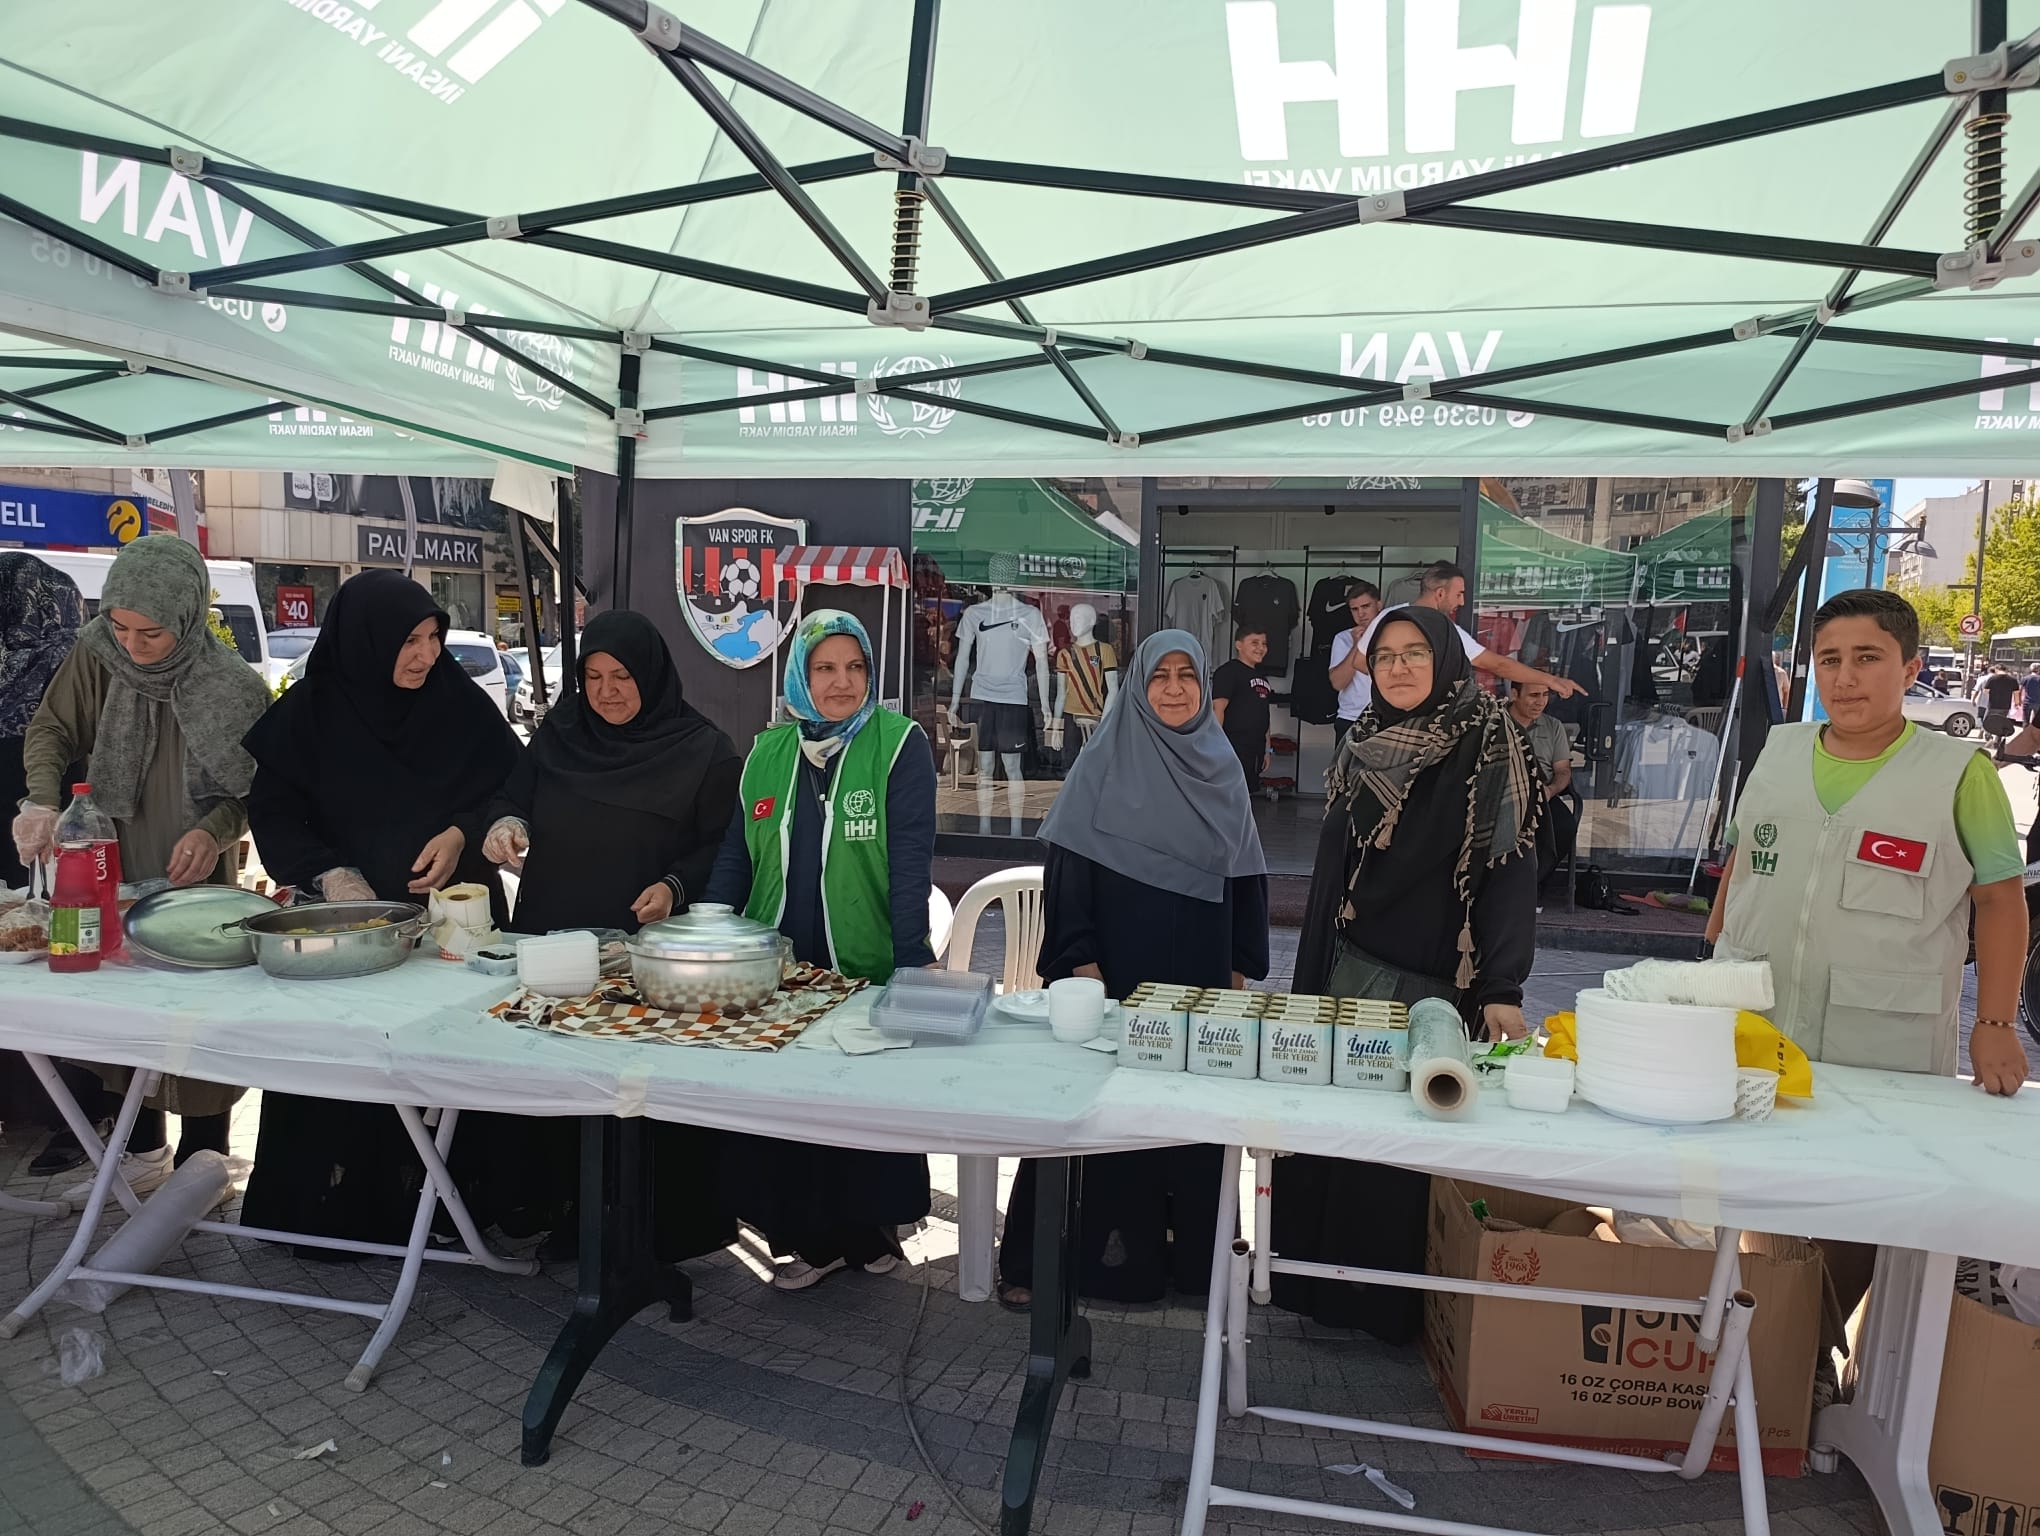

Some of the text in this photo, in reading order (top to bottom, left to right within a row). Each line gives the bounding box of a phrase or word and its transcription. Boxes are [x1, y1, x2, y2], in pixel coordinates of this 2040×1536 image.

[708, 527, 774, 545] VAN SPOR FK
[1128, 1039, 1145, 1047] HER
[1197, 1045, 1215, 1054] HER
[1271, 1052, 1289, 1060] HER
[1346, 1058, 1365, 1067] HER
[1559, 1373, 1577, 1386] 16
[1609, 1378, 1668, 1394] ÇORBA
[1570, 1391, 1588, 1402] 16
[1616, 1394, 1664, 1407] SOUP
[1767, 1426, 1791, 1438] Pcs
